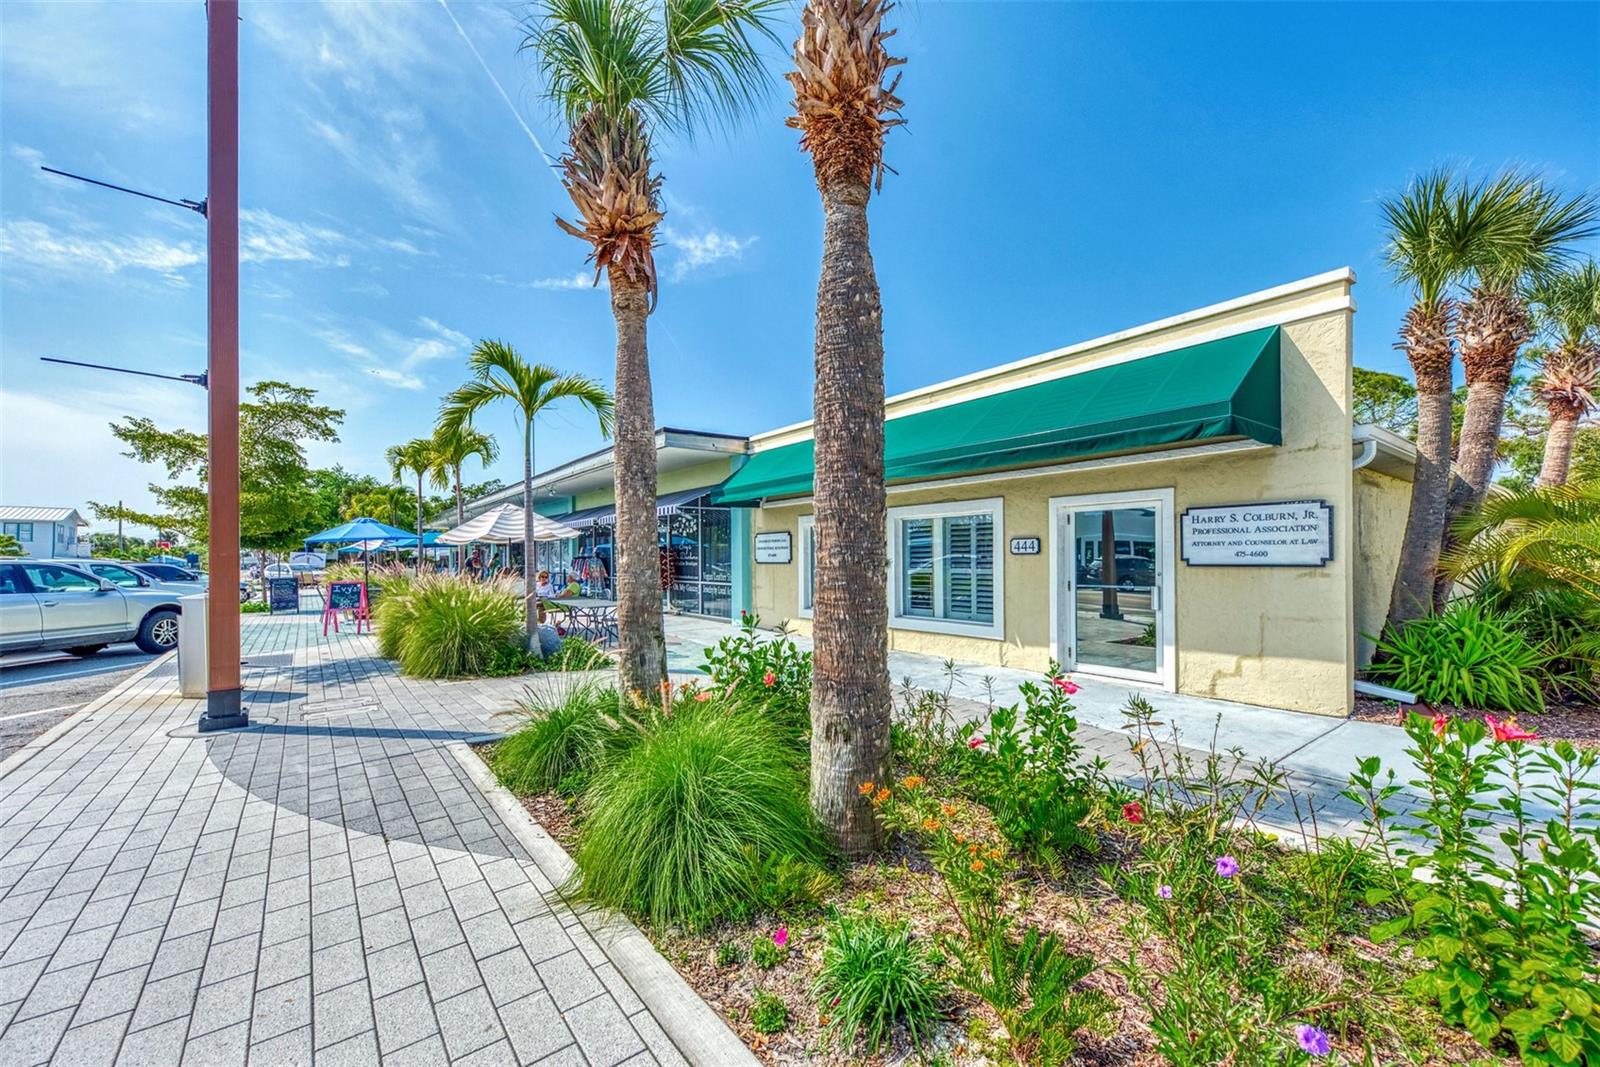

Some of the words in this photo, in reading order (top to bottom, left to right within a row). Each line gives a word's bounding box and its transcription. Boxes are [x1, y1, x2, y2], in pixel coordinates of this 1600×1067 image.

[1191, 515, 1226, 524] HARRY
[1229, 513, 1239, 523] S.
[1243, 512, 1298, 521] COLBURN,
[1302, 510, 1319, 519] JR.
[1192, 527, 1252, 535] PROFESSIONAL
[1254, 524, 1318, 533] ASSOCIATION
[1013, 540, 1036, 552] 444
